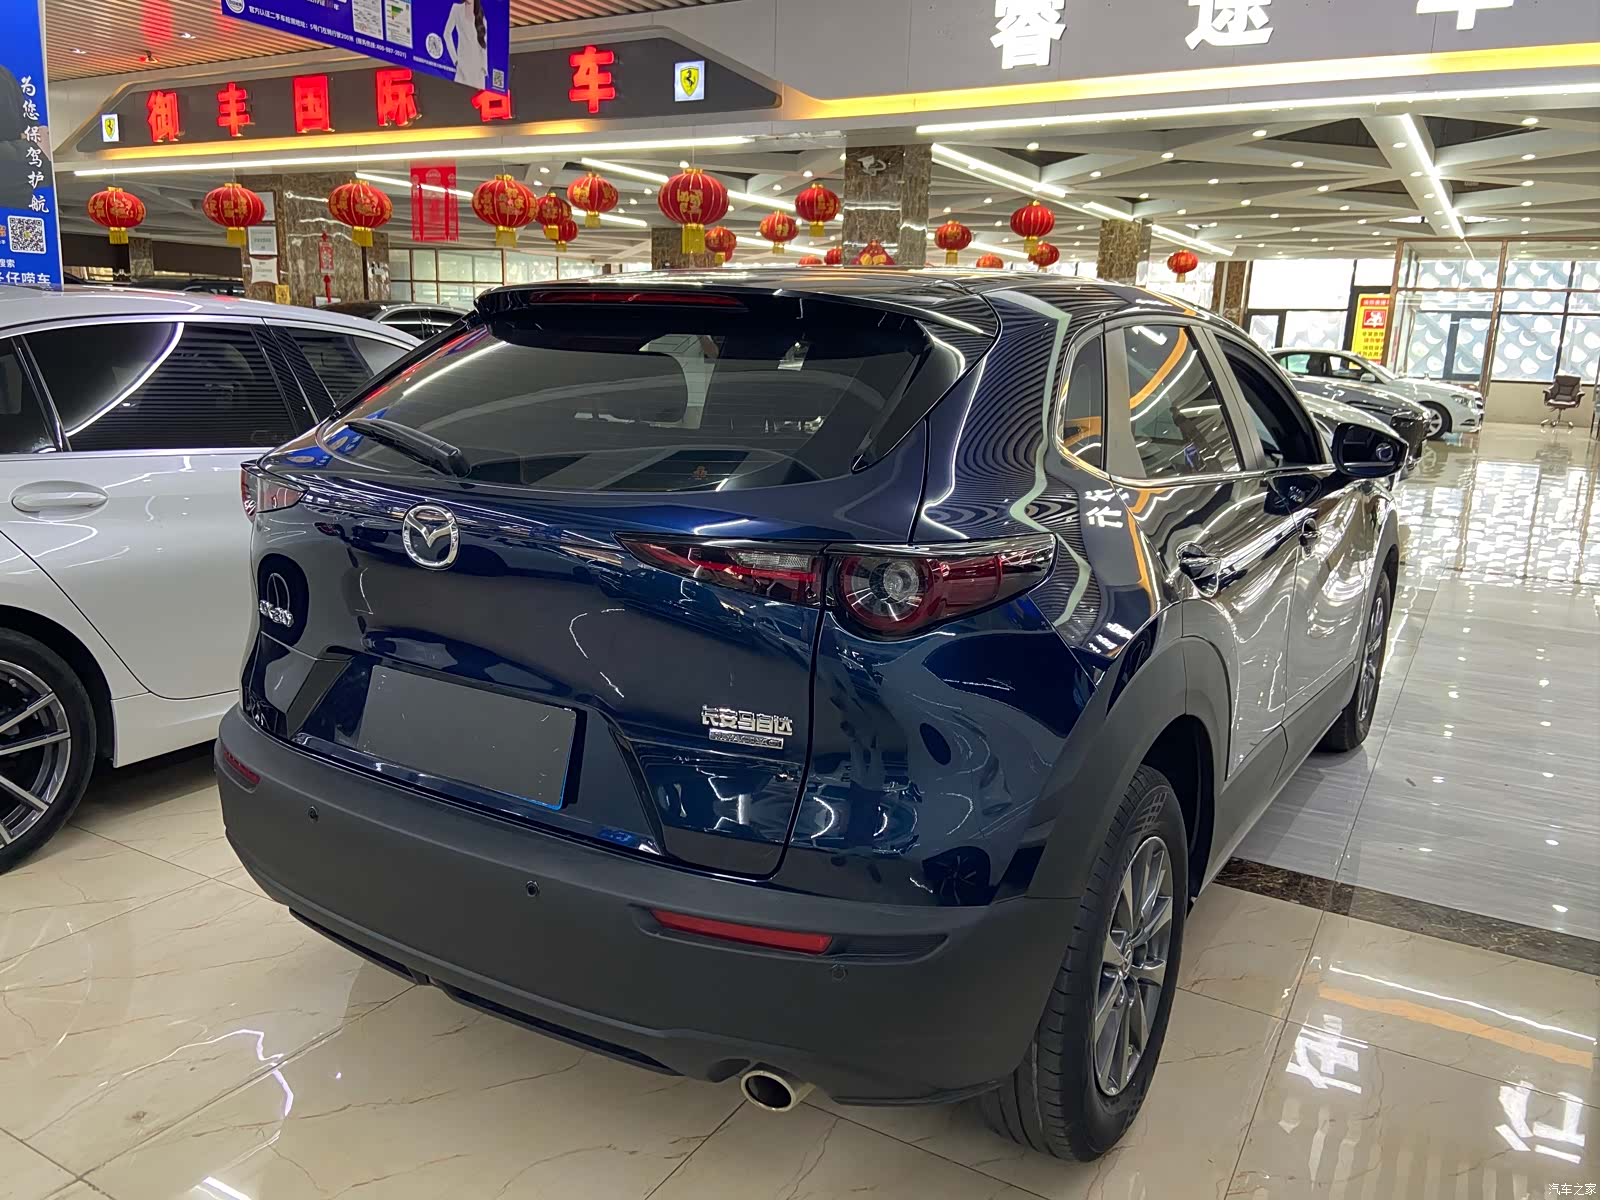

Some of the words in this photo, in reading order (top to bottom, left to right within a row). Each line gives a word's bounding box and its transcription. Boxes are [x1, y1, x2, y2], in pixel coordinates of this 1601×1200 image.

[20, 75, 49, 213] 为您保驾护航
[701, 704, 793, 736] 长安马自达
